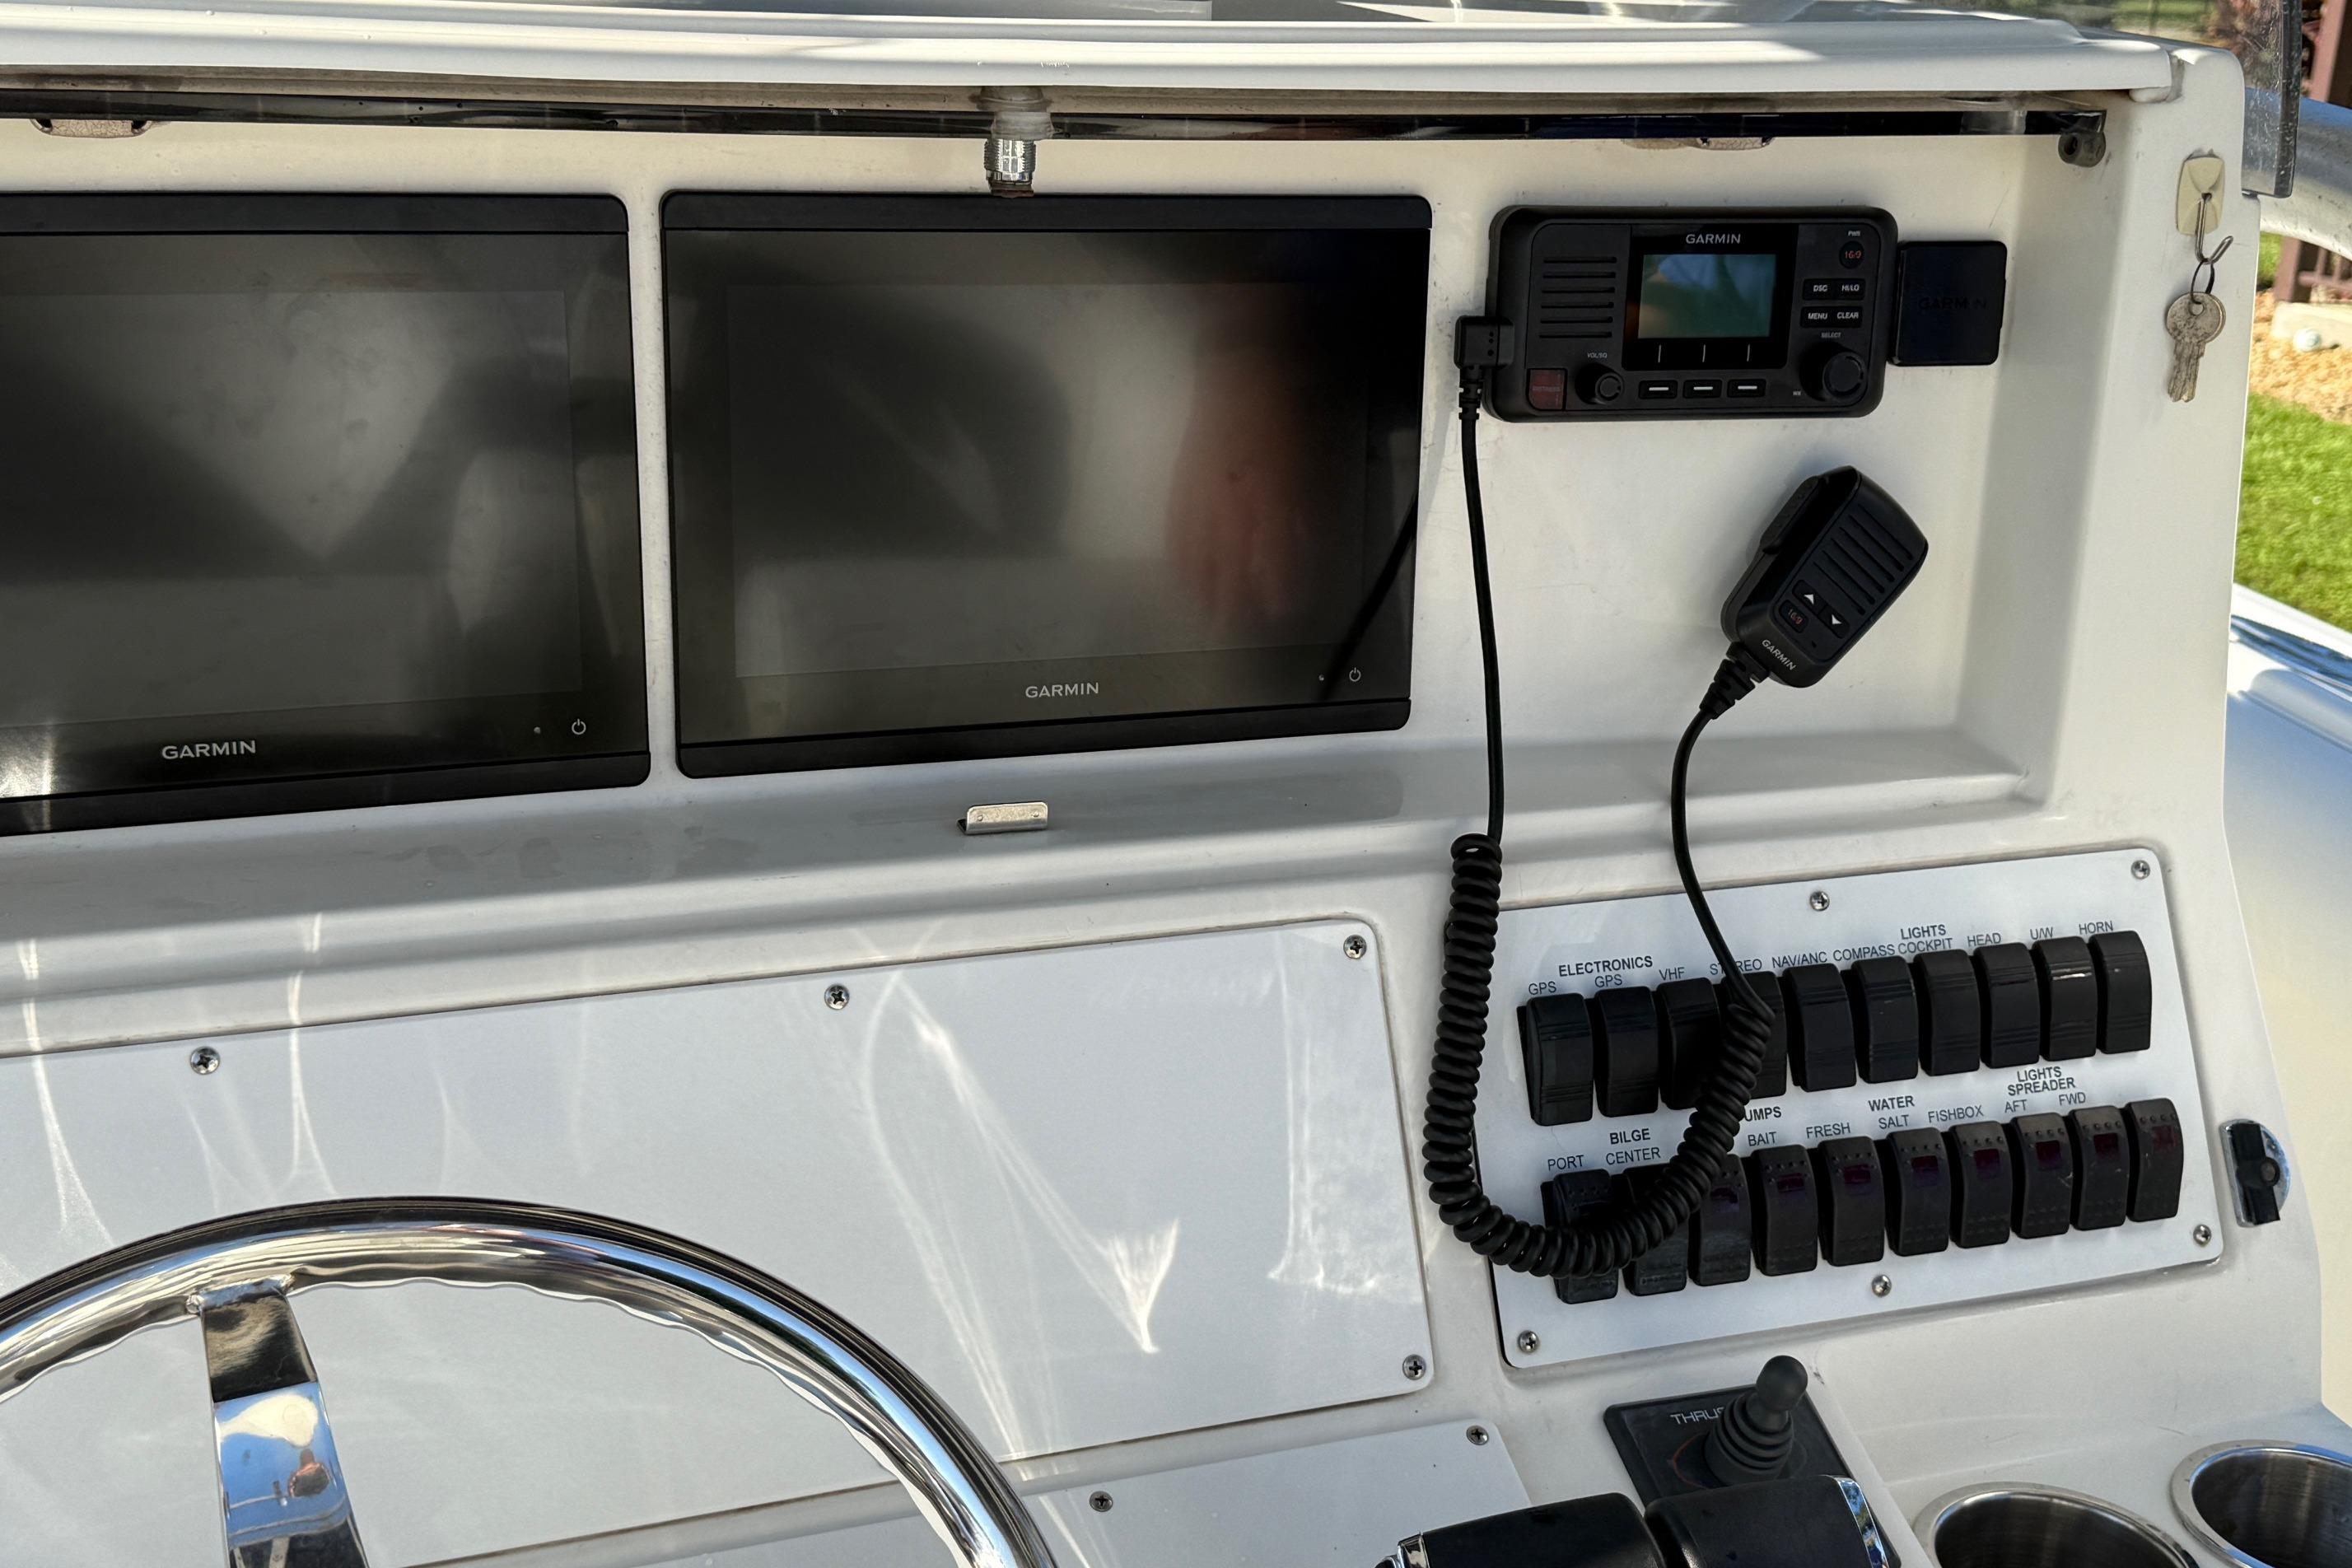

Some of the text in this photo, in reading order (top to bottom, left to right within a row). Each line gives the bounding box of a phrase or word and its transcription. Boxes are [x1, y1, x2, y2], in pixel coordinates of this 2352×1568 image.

[1685, 232, 1742, 245] GARMIN
[1813, 284, 1828, 292] DSC
[1918, 296, 1987, 310] GARMN
[1808, 312, 1828, 320] MENU
[1836, 311, 1860, 320] CLEAR
[1762, 639, 1796, 670] GARMIN
[1024, 682, 1100, 699] GARMIN
[161, 740, 257, 760] GARMIN
[1900, 924, 1947, 940] LIGHTS
[1528, 921, 2115, 996] GPS GPS VHF STREO NAV/ANC COMPASS COCKPIT HEAD U/W HORN
[1558, 955, 1654, 978] ELECTRONICS
[2017, 1066, 2062, 1083] LIGHTS
[2007, 1077, 2076, 1097] SPREADER
[1868, 1095, 1916, 1113] WATER
[1744, 1106, 1782, 1122] UMPS
[1547, 1092, 2087, 1172] PORT CENTER BAIT FRESH SALT FISHBOX AFT FWD
[1609, 1128, 1651, 1146] BILGE
